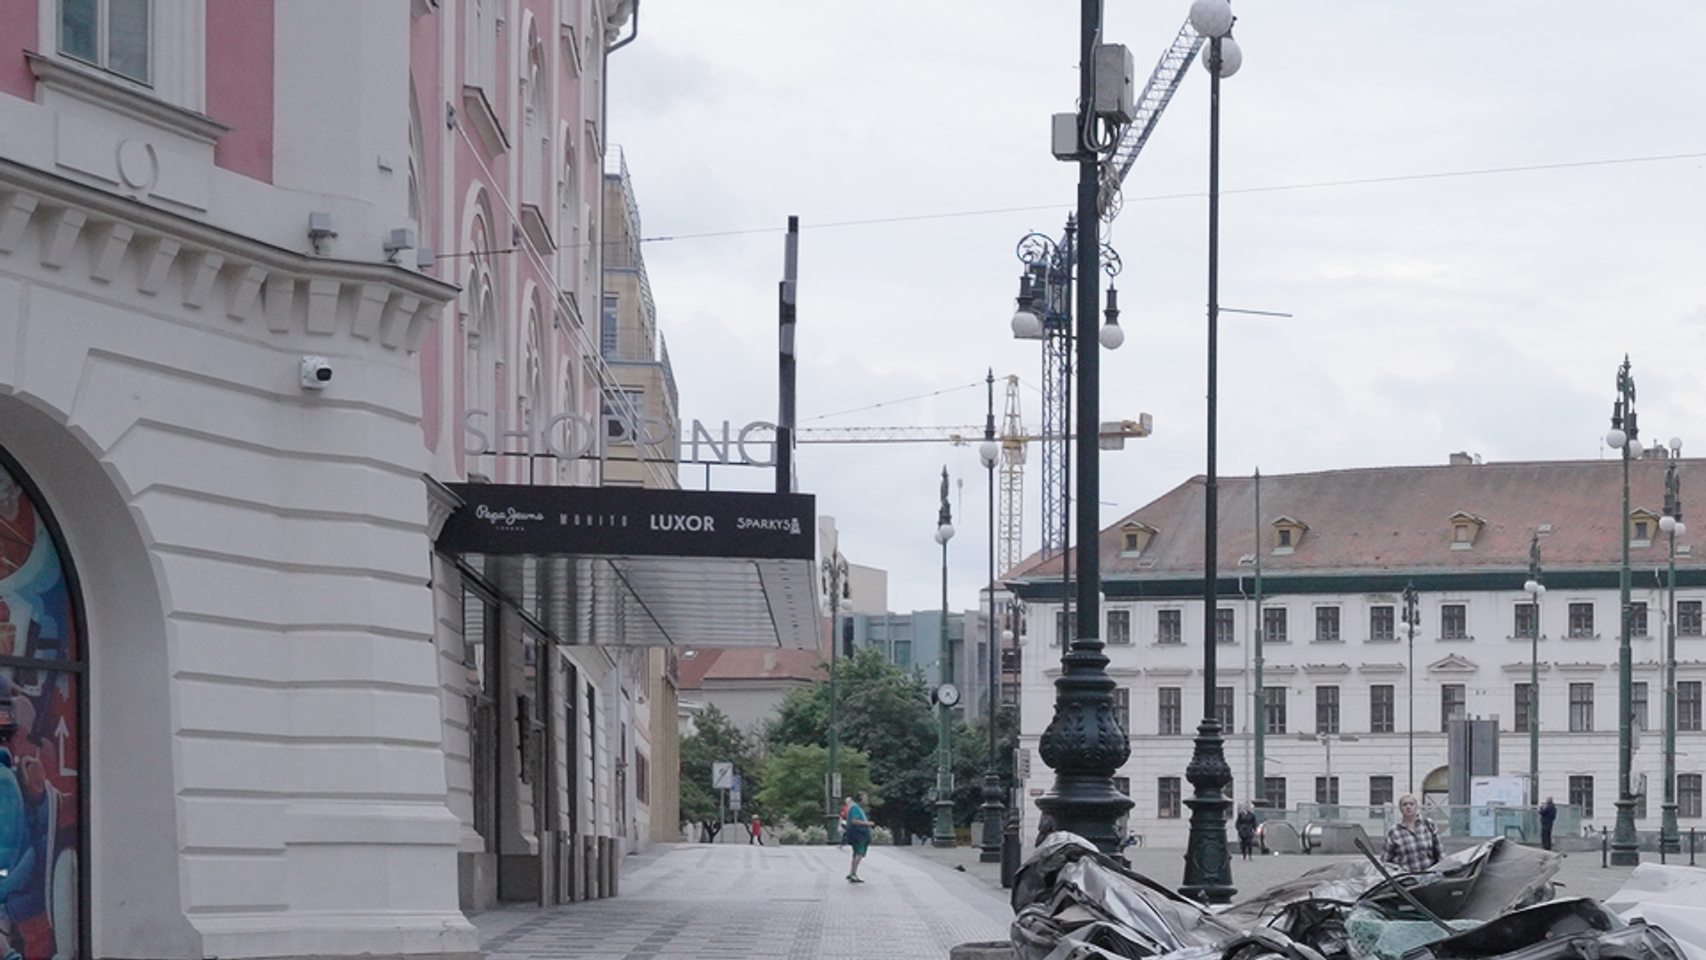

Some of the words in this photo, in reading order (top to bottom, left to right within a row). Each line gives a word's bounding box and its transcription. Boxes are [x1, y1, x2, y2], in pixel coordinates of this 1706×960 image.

[461, 408, 777, 467] SHOPPING
[506, 507, 545, 525] Jeans
[650, 514, 715, 532] LUXOR
[737, 517, 790, 530] SPARKYS
